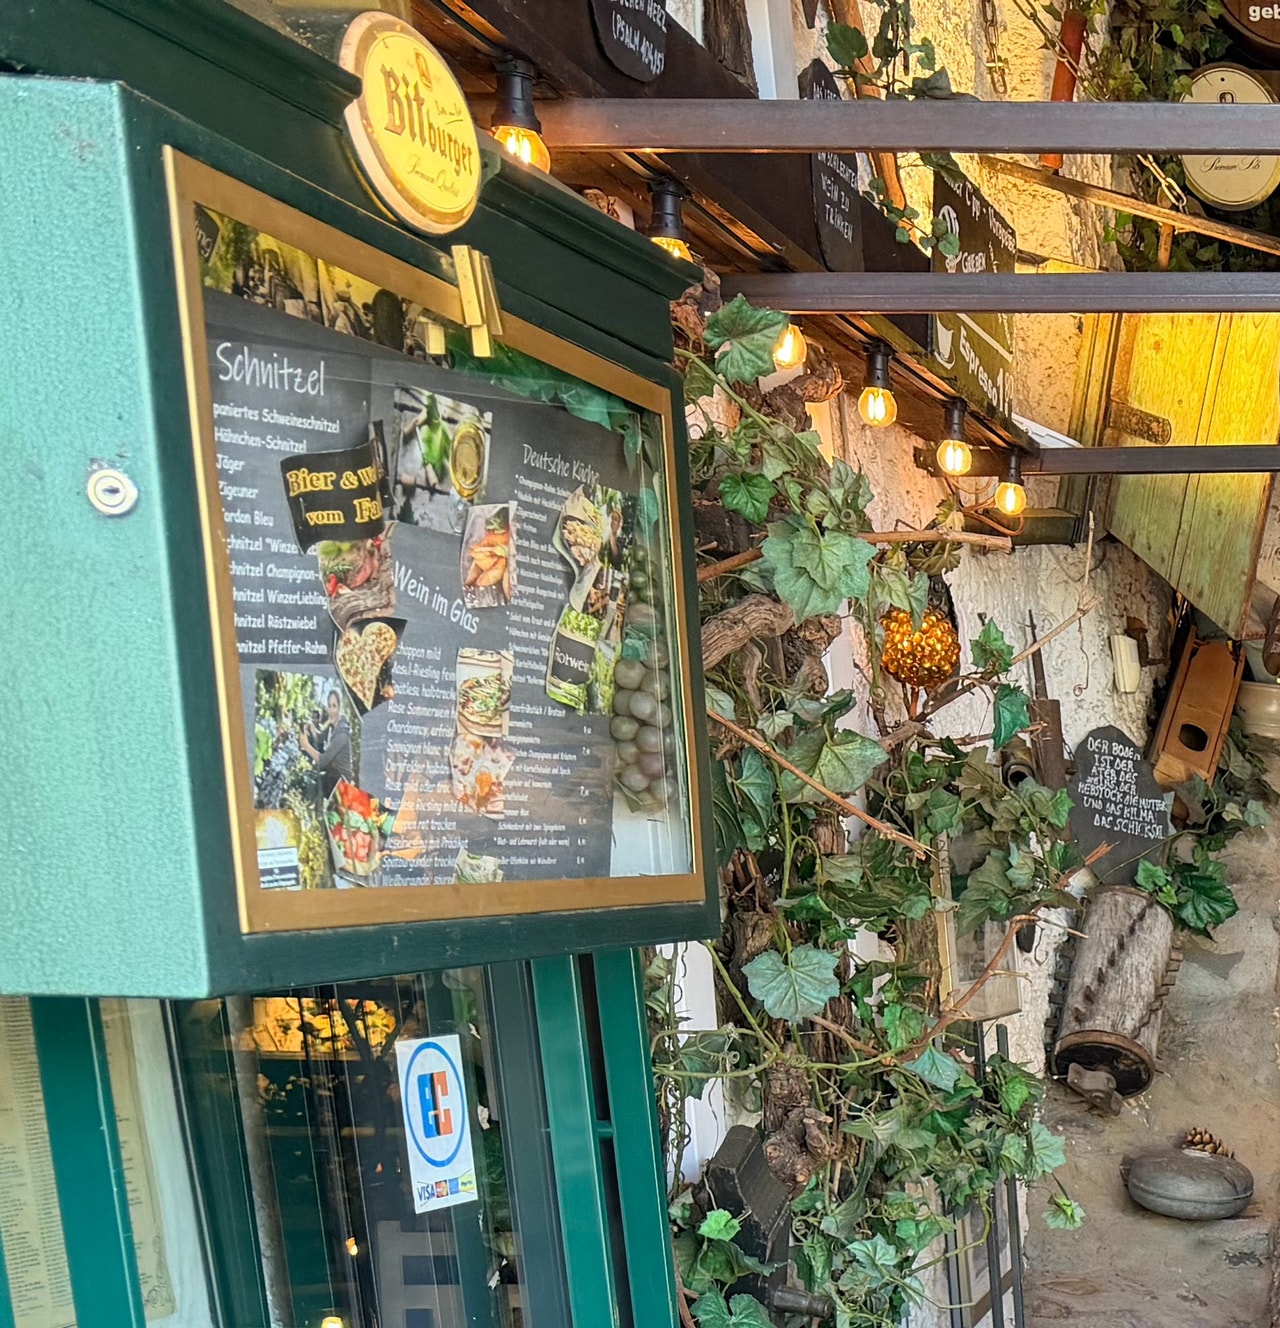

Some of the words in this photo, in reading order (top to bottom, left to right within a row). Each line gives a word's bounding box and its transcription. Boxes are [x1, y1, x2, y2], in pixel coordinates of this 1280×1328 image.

[379, 63, 473, 176] Bitburger
[216, 342, 325, 396] Schnitzel
[960, 326, 998, 407] Espresso
[213, 403, 259, 421] paniertes
[262, 408, 340, 434] Schweineschnitzel
[216, 454, 245, 473] Jäger
[523, 443, 569, 478] Deutsche
[287, 468, 336, 496] Bier
[340, 471, 358, 489] &
[222, 508, 252, 524] ordon
[254, 510, 274, 526] Bleu
[306, 510, 345, 526] vom
[393, 561, 430, 605] Wein
[432, 586, 448, 617] im
[450, 598, 480, 634] Glas
[268, 614, 317, 630] Röstzwiebel
[1087, 736, 1109, 754] DER
[1112, 742, 1141, 760] BODEN
[1094, 754, 1114, 769] IST
[1114, 757, 1134, 772] DER
[1119, 772, 1138, 783] DES
[1119, 782, 1136, 795] DER
[1083, 796, 1103, 810] UND
[1106, 802, 1123, 816] DAS
[1124, 795, 1139, 806] DIE
[1093, 813, 1114, 829] DAS
[417, 1183, 436, 1203] VISA
